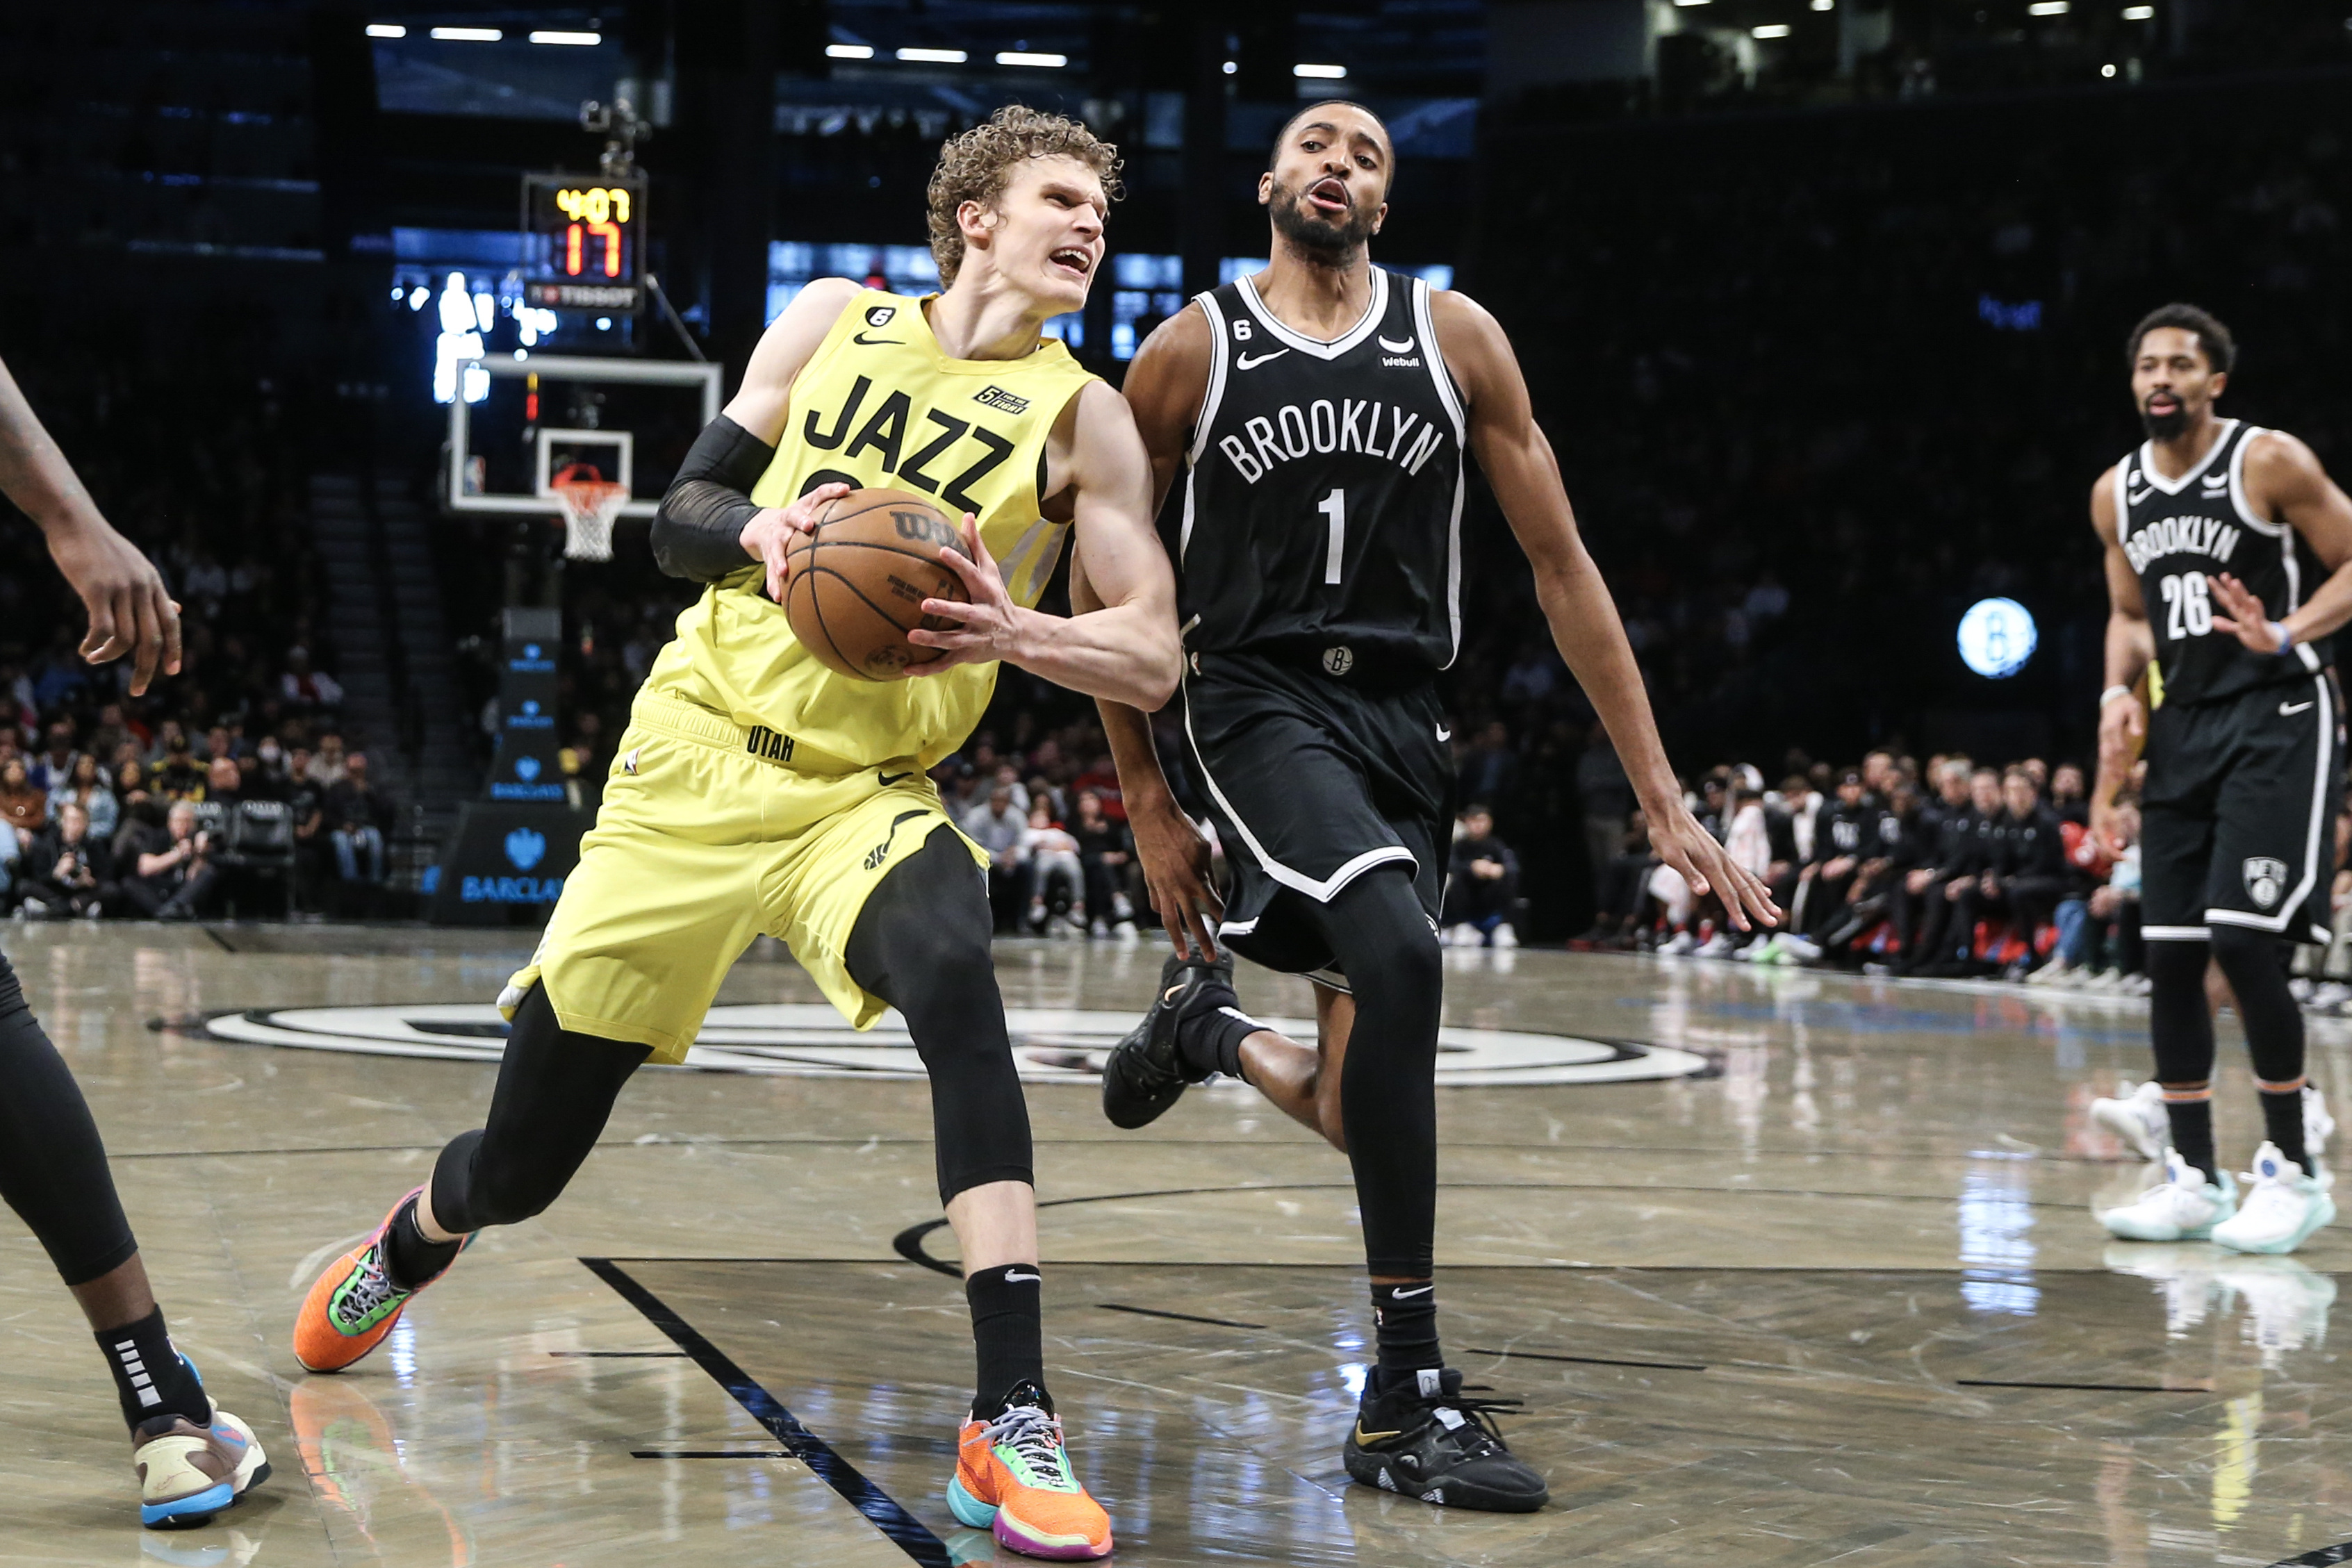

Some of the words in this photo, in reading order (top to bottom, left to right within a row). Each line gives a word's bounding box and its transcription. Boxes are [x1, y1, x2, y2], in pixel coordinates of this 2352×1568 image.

[566, 222, 621, 277] 17
[869, 308, 893, 326] 6
[1233, 320, 1253, 340] 6
[1382, 356, 1420, 368] Webull
[978, 387, 1001, 402] 5
[992, 399, 1024, 413] FIGHT
[804, 374, 1015, 518] JAZZ
[1219, 398, 1444, 484] BROOKLYN
[1317, 488, 1344, 584] 1
[2124, 515, 2242, 575] BROOKLYN
[2160, 570, 2214, 641] 26
[1331, 648, 1345, 671] B
[747, 725, 795, 761] UTAH
[461, 875, 565, 902] BARCLA
